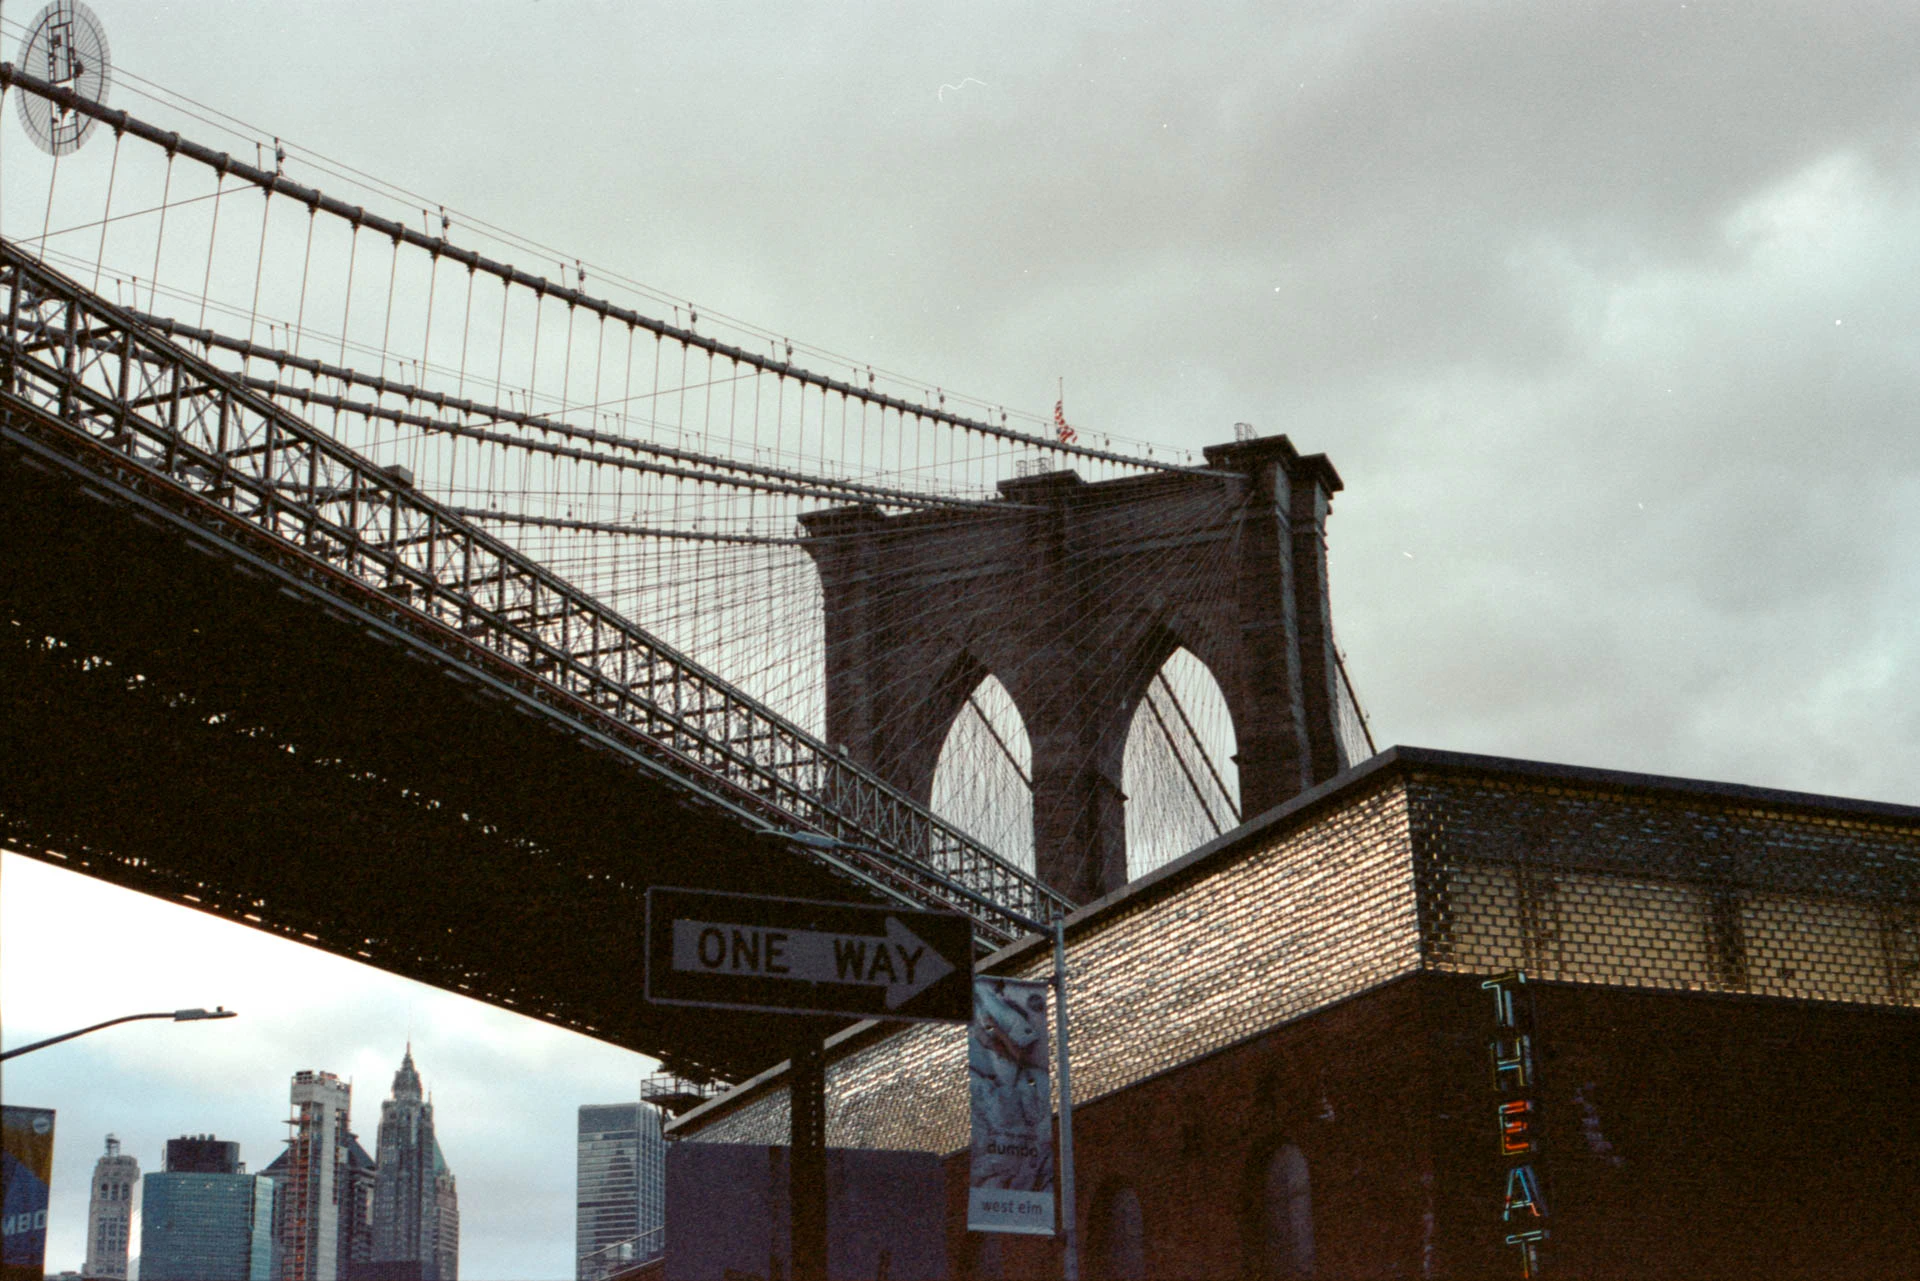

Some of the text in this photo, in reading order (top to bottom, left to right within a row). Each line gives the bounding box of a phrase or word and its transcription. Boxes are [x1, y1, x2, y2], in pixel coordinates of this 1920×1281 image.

[699, 927, 924, 985] ONE WAY
[986, 1139, 1039, 1158] dumbo
[982, 1200, 1043, 1215] west elm
